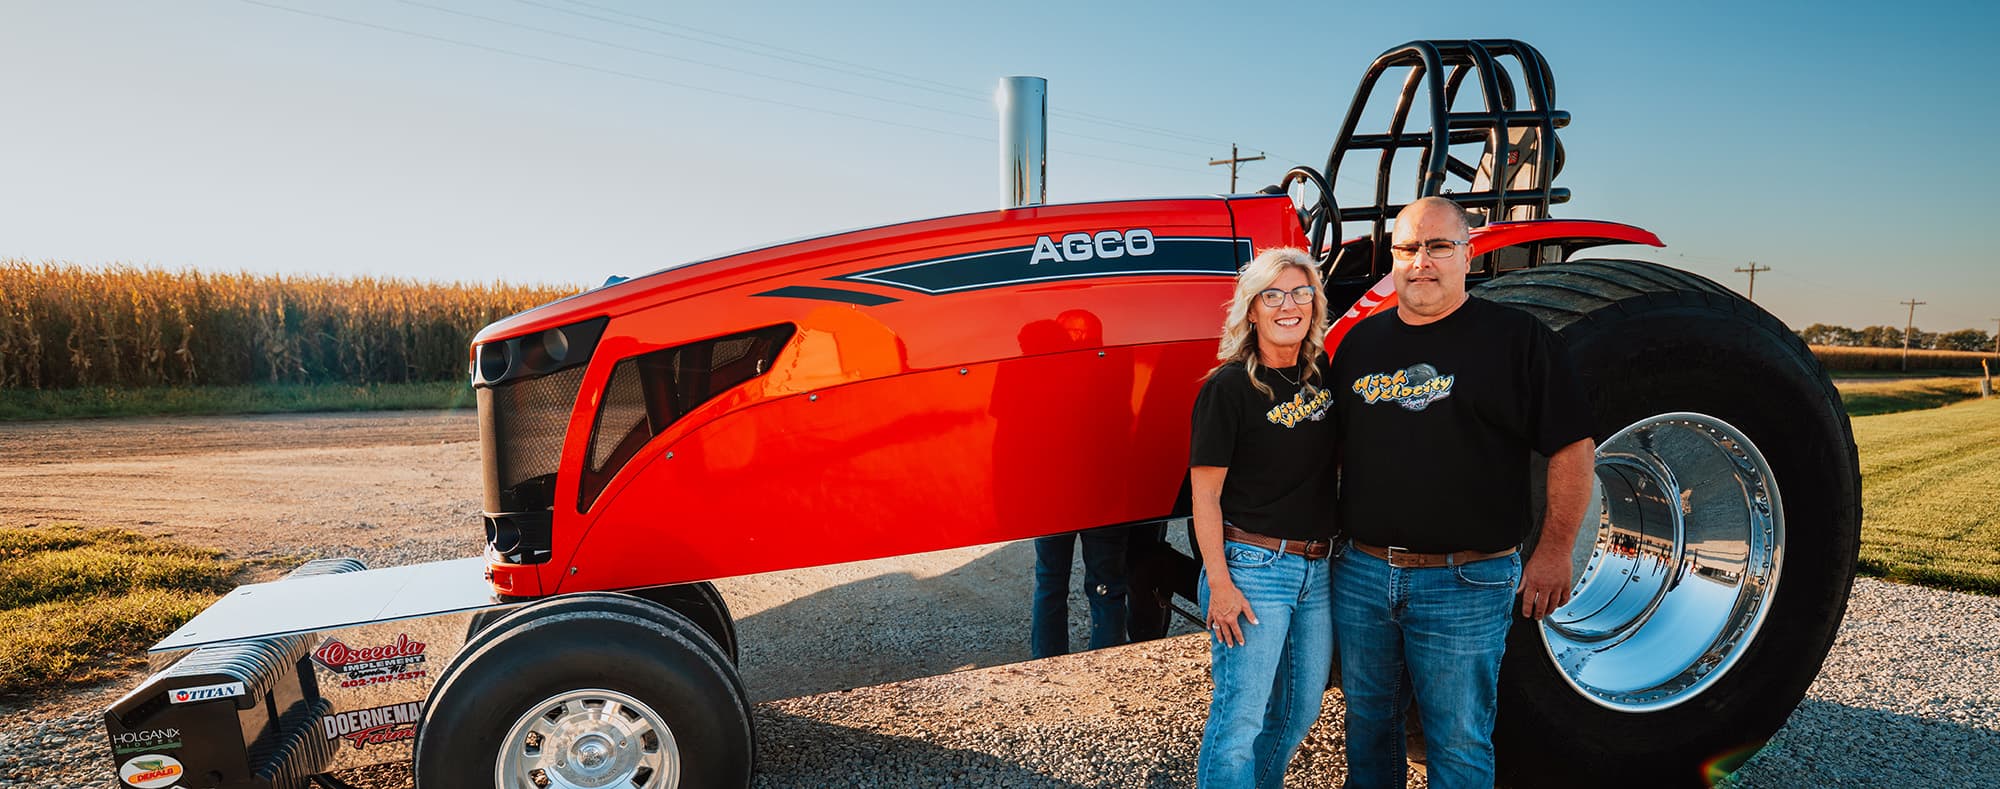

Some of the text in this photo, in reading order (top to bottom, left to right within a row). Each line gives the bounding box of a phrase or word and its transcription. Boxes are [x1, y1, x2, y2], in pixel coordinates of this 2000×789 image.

[1029, 228, 1155, 265] AGCO
[1353, 369, 1408, 394] High
[1363, 375, 1454, 404] Velocity
[316, 633, 426, 665] Osceola
[343, 655, 423, 672] IMPLEMENT
[190, 686, 236, 700] TITAN
[113, 728, 180, 744] HOLGANIX
[137, 767, 174, 782] DEKALB
